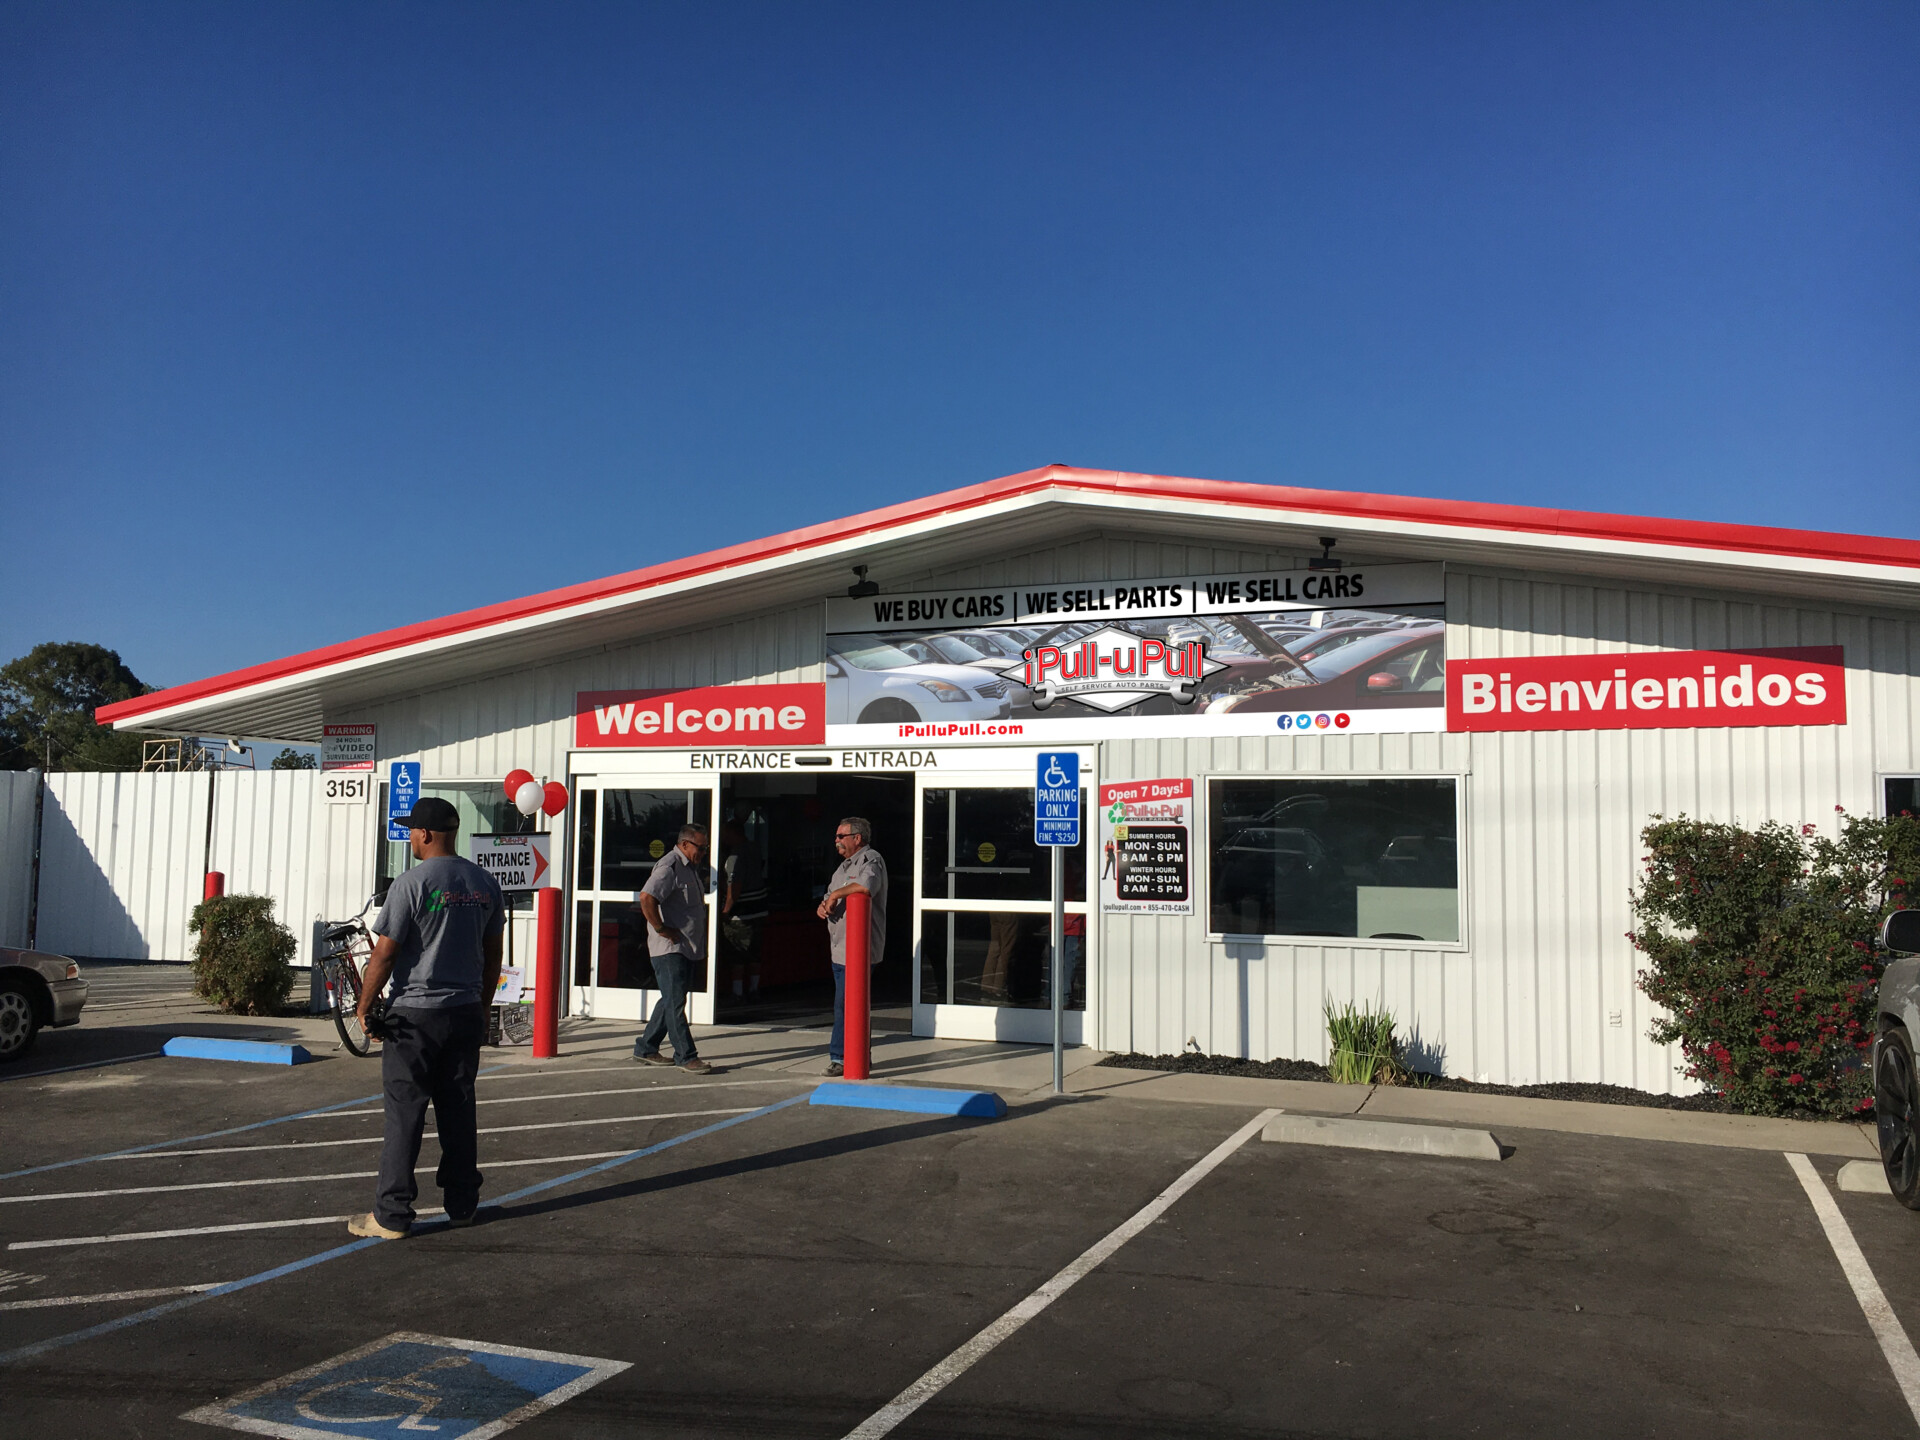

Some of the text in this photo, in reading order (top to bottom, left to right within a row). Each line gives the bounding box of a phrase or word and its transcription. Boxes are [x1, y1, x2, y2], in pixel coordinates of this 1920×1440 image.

[1205, 573, 1364, 604] WE SELL CARS
[1025, 584, 1183, 614] WE SELL PARTS
[874, 594, 1005, 622] WE BUY CARS
[1081, 682, 1113, 690] SERVICE
[1140, 681, 1165, 689] PARTS
[1461, 663, 1827, 714] Bienvienidos
[594, 701, 806, 735] Welcome
[328, 726, 373, 735] WARNING
[898, 723, 1024, 737] iPulluPull.com
[339, 743, 374, 752] VIDEO
[690, 752, 791, 769] ENTRANCE
[842, 751, 938, 768] ENTRADA
[326, 779, 364, 798] 3151
[395, 787, 414, 795] PARKING
[1038, 788, 1077, 802] PARKING
[1107, 782, 1184, 802] Open 7 Days!
[1045, 803, 1070, 817] ONLY
[1043, 821, 1072, 831] MINIMUM
[389, 830, 400, 838] FINE
[1038, 832, 1076, 842] FINE $250
[477, 851, 530, 868] ENTRANCE
[1121, 853, 1128, 862] 8
[1130, 853, 1148, 862] AM
[1157, 853, 1164, 862] 6
[1166, 853, 1184, 862] PM
[492, 871, 526, 886] TRADA
[1122, 884, 1129, 892] 8
[1131, 884, 1148, 892] AM
[1157, 885, 1164, 893] 5
[1166, 885, 1183, 893] PM
[1147, 904, 1190, 912] 855-470-CASH
